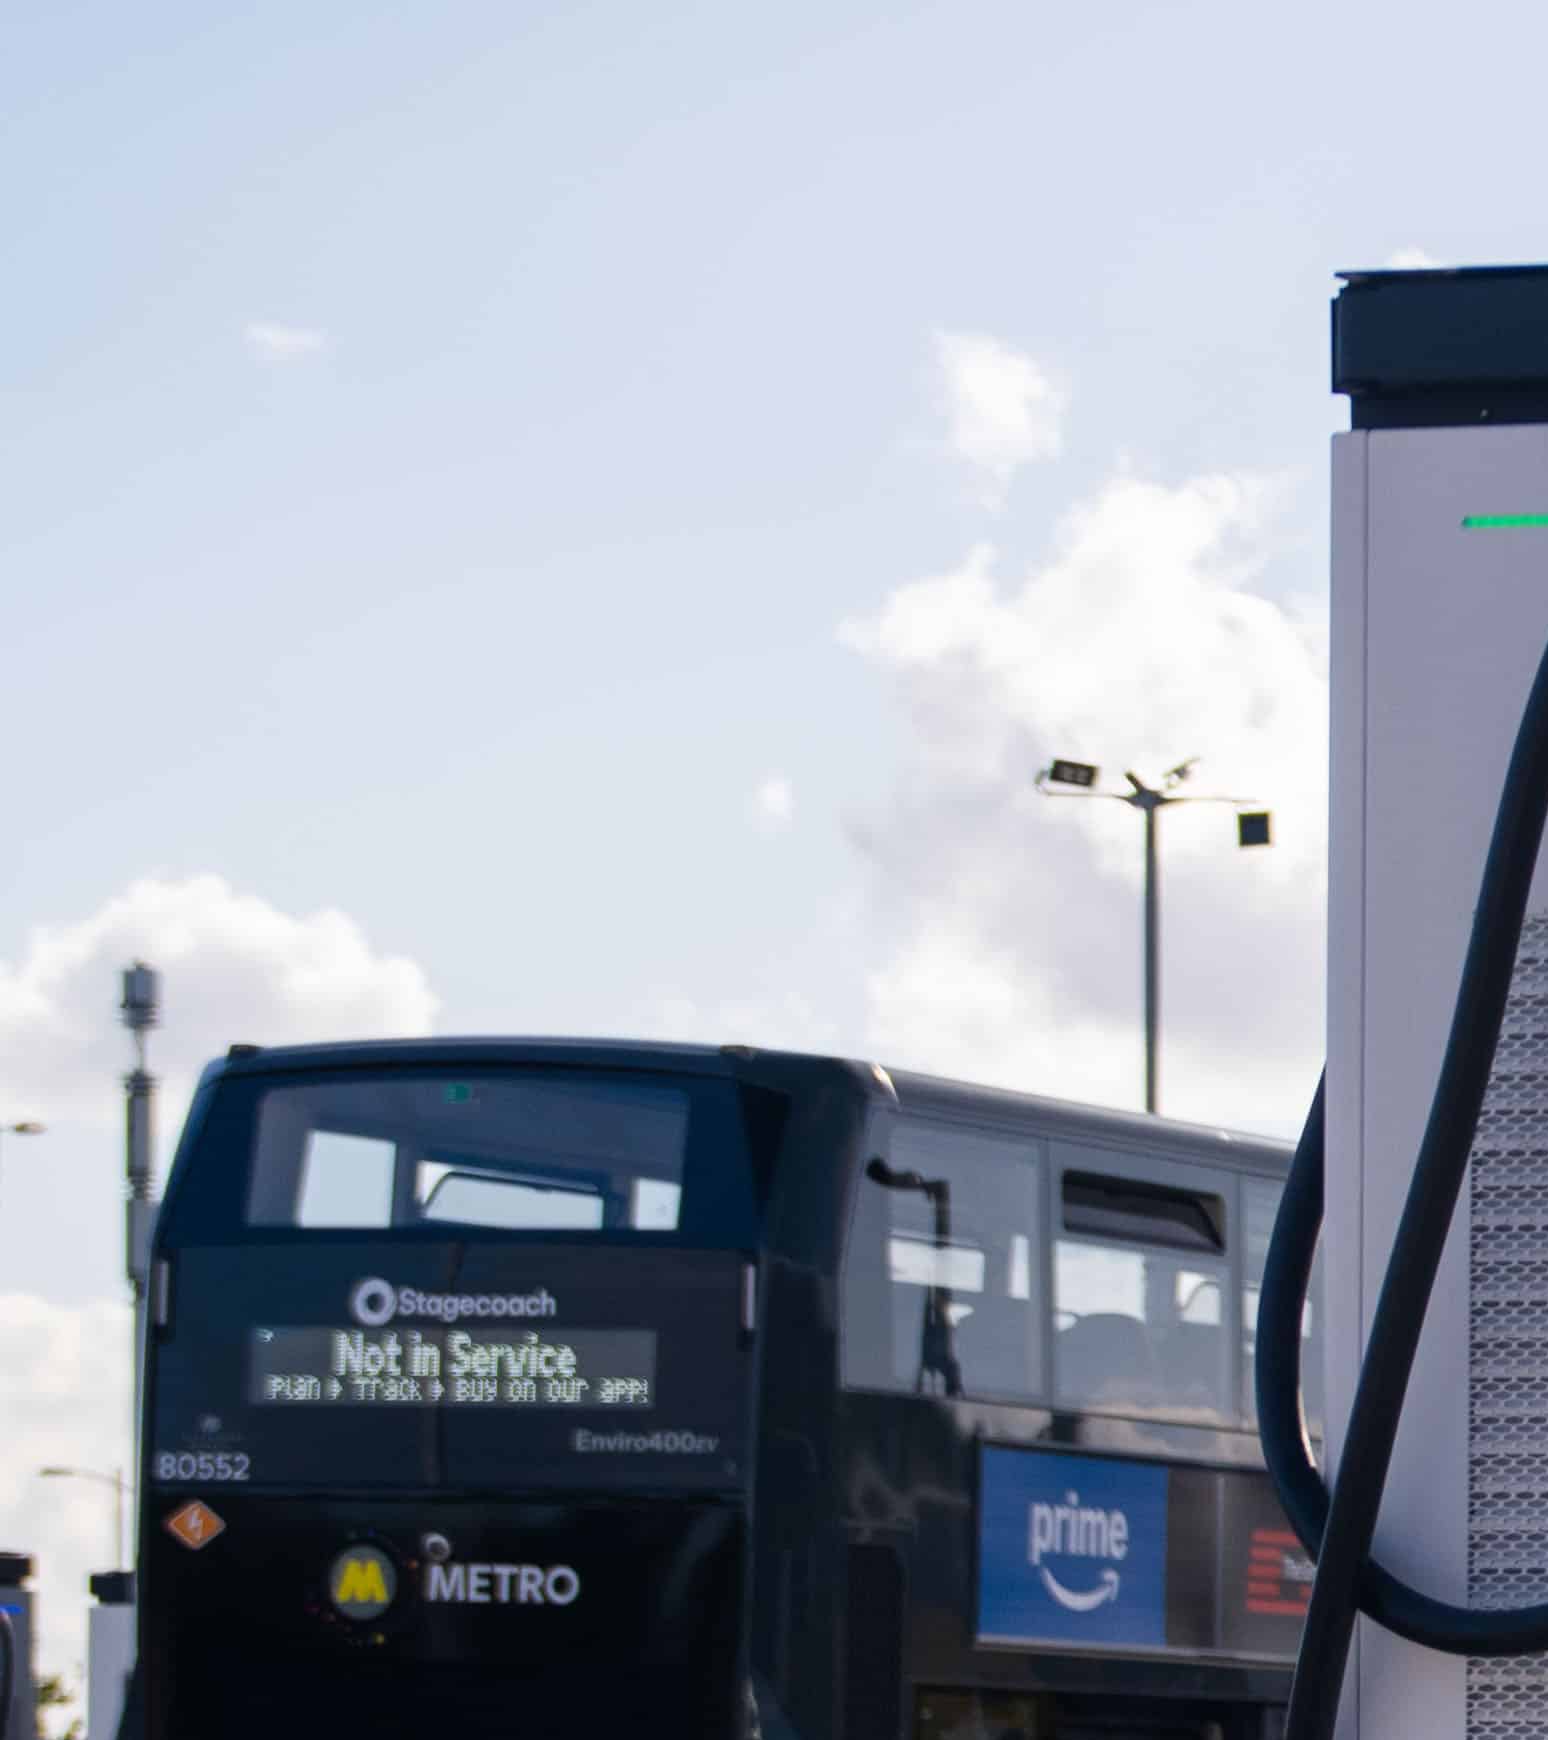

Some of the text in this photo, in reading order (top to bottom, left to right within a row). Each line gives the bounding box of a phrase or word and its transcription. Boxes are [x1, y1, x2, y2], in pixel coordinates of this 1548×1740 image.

[400, 1288, 557, 1322] Stagecoach
[333, 1329, 577, 1378] Not in Service
[159, 1452, 250, 1481] 80552
[1028, 1488, 1130, 1566] prime
[428, 1563, 580, 1606] METRO
